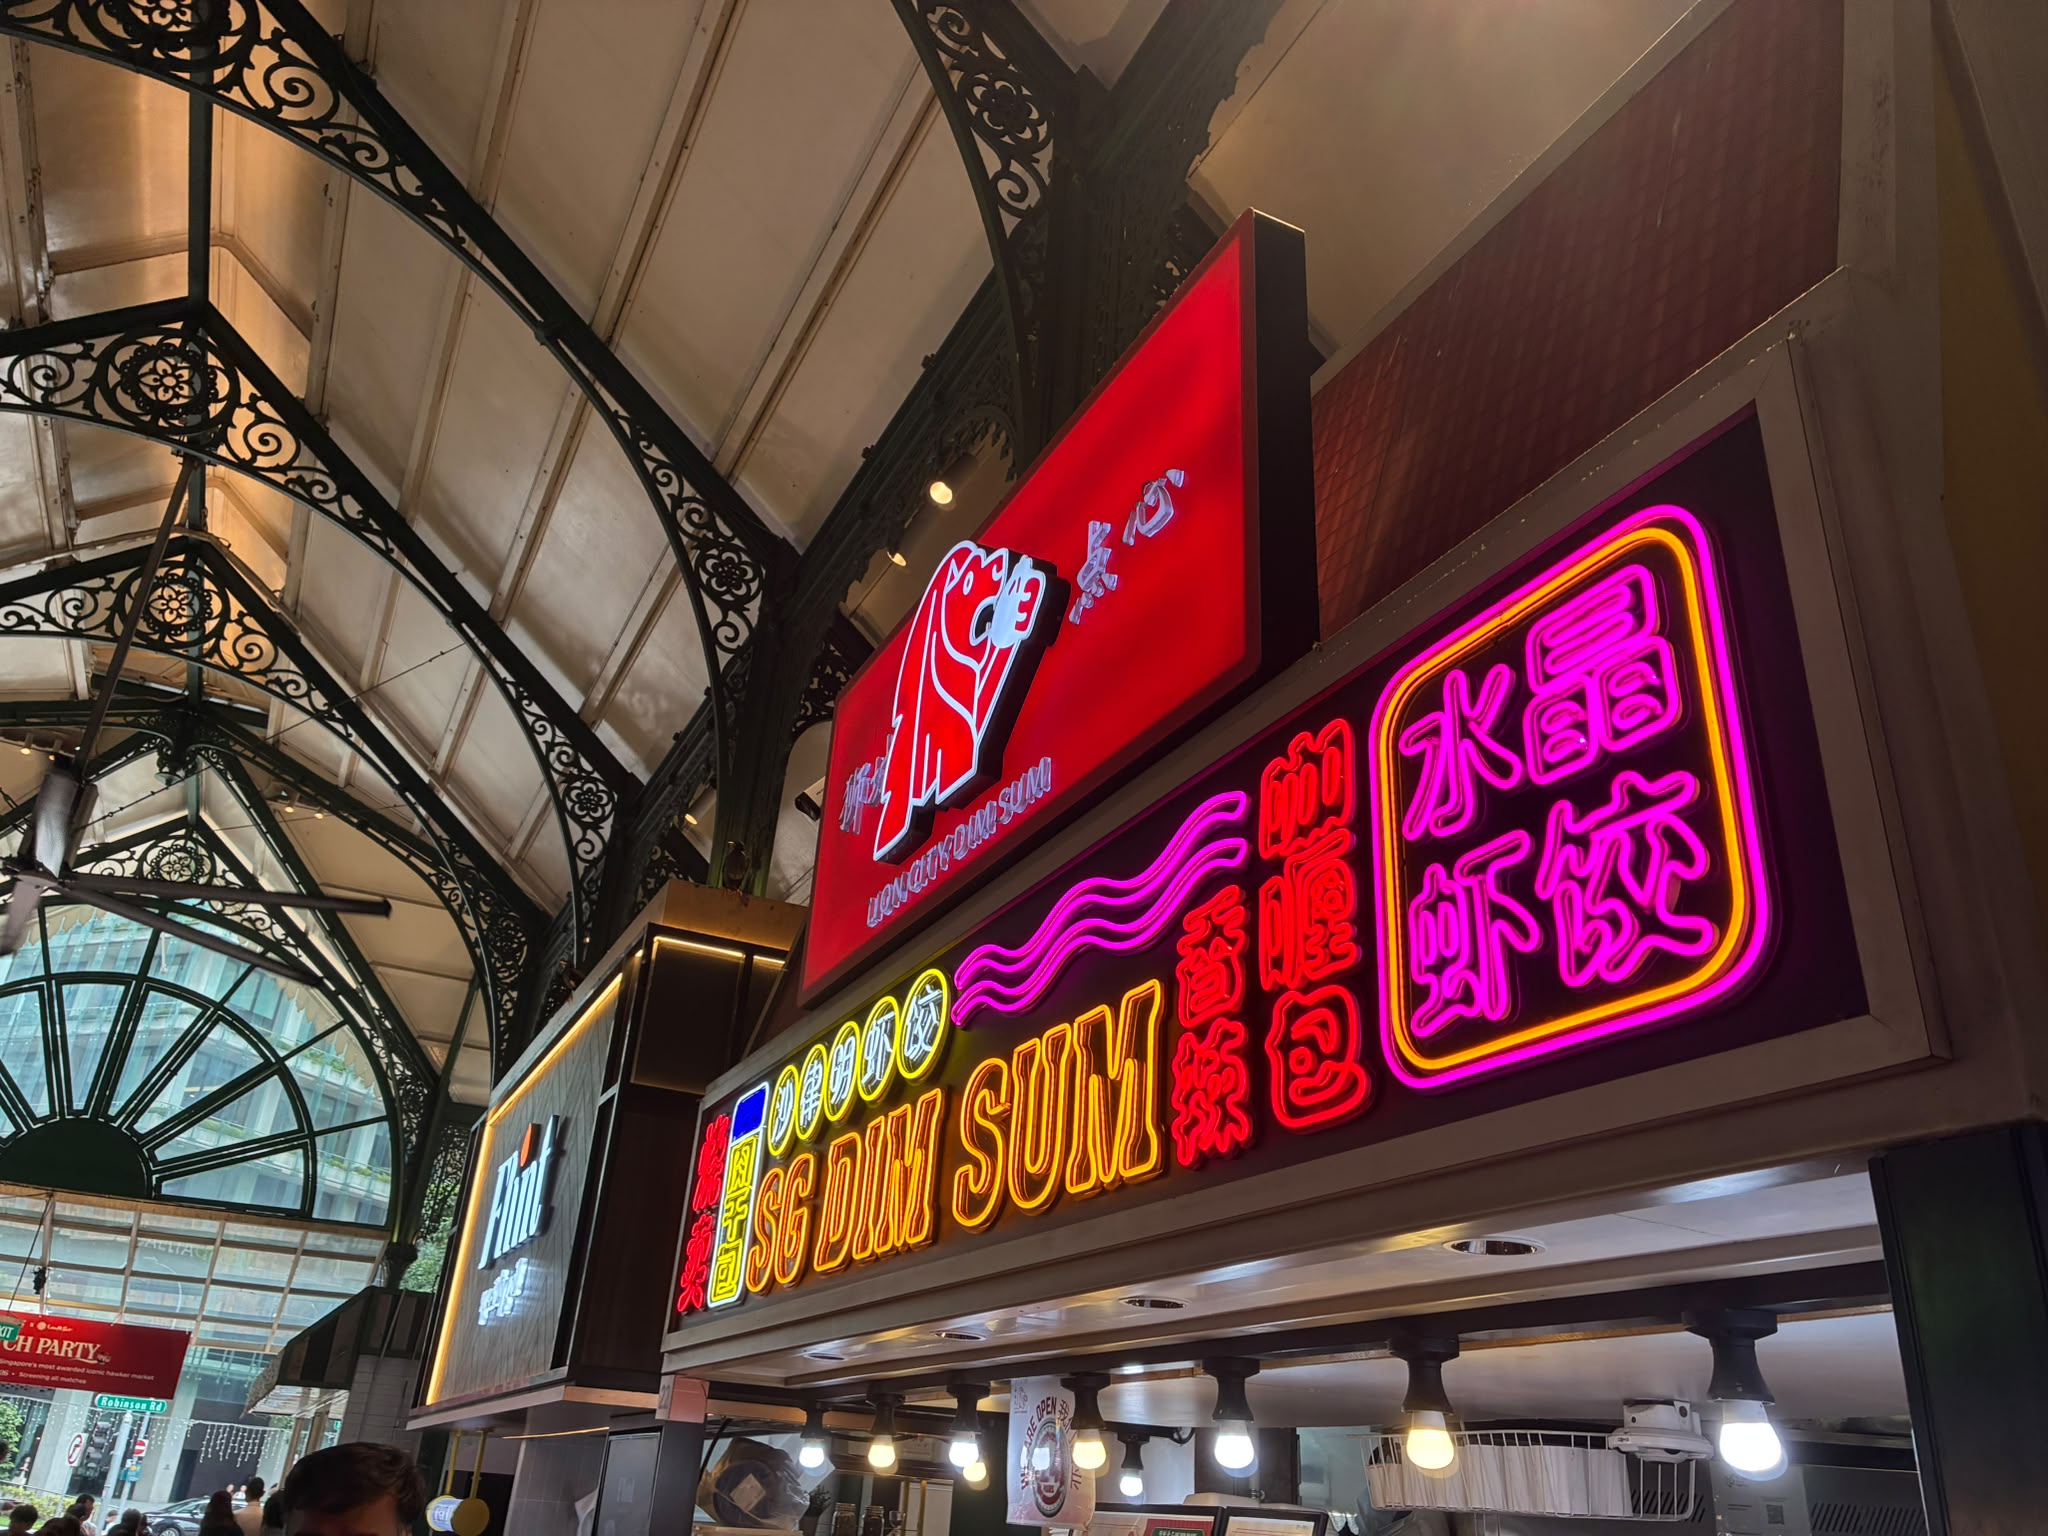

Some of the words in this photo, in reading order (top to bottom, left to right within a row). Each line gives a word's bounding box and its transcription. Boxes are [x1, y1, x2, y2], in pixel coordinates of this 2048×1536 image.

[1069, 469, 1185, 625] 点心
[1400, 564, 1682, 840] 水晶
[867, 872, 908, 928] LION
[908, 834, 954, 893] CITY
[953, 800, 997, 860] DIM
[996, 757, 1052, 824] SUM
[1408, 771, 1718, 1038] 虾饺
[1258, 718, 1371, 1129] 咖喱包
[478, 1115, 557, 1270] Flint
[746, 1152, 815, 1294] SG
[813, 1088, 943, 1274] DIM
[952, 978, 1163, 1229] SUM
[19, 1371, 50, 1381] Screening
[60, 1375, 87, 1384] matches
[35, 1337, 101, 1362] PARTY
[56, 1365, 85, 1374] awarded
[106, 1370, 130, 1378] hawker
[131, 1373, 155, 1381] market
[101, 1396, 147, 1410] Robinson
[149, 1401, 163, 1412] Rd
[1036, 1396, 1057, 1423] OPEN
